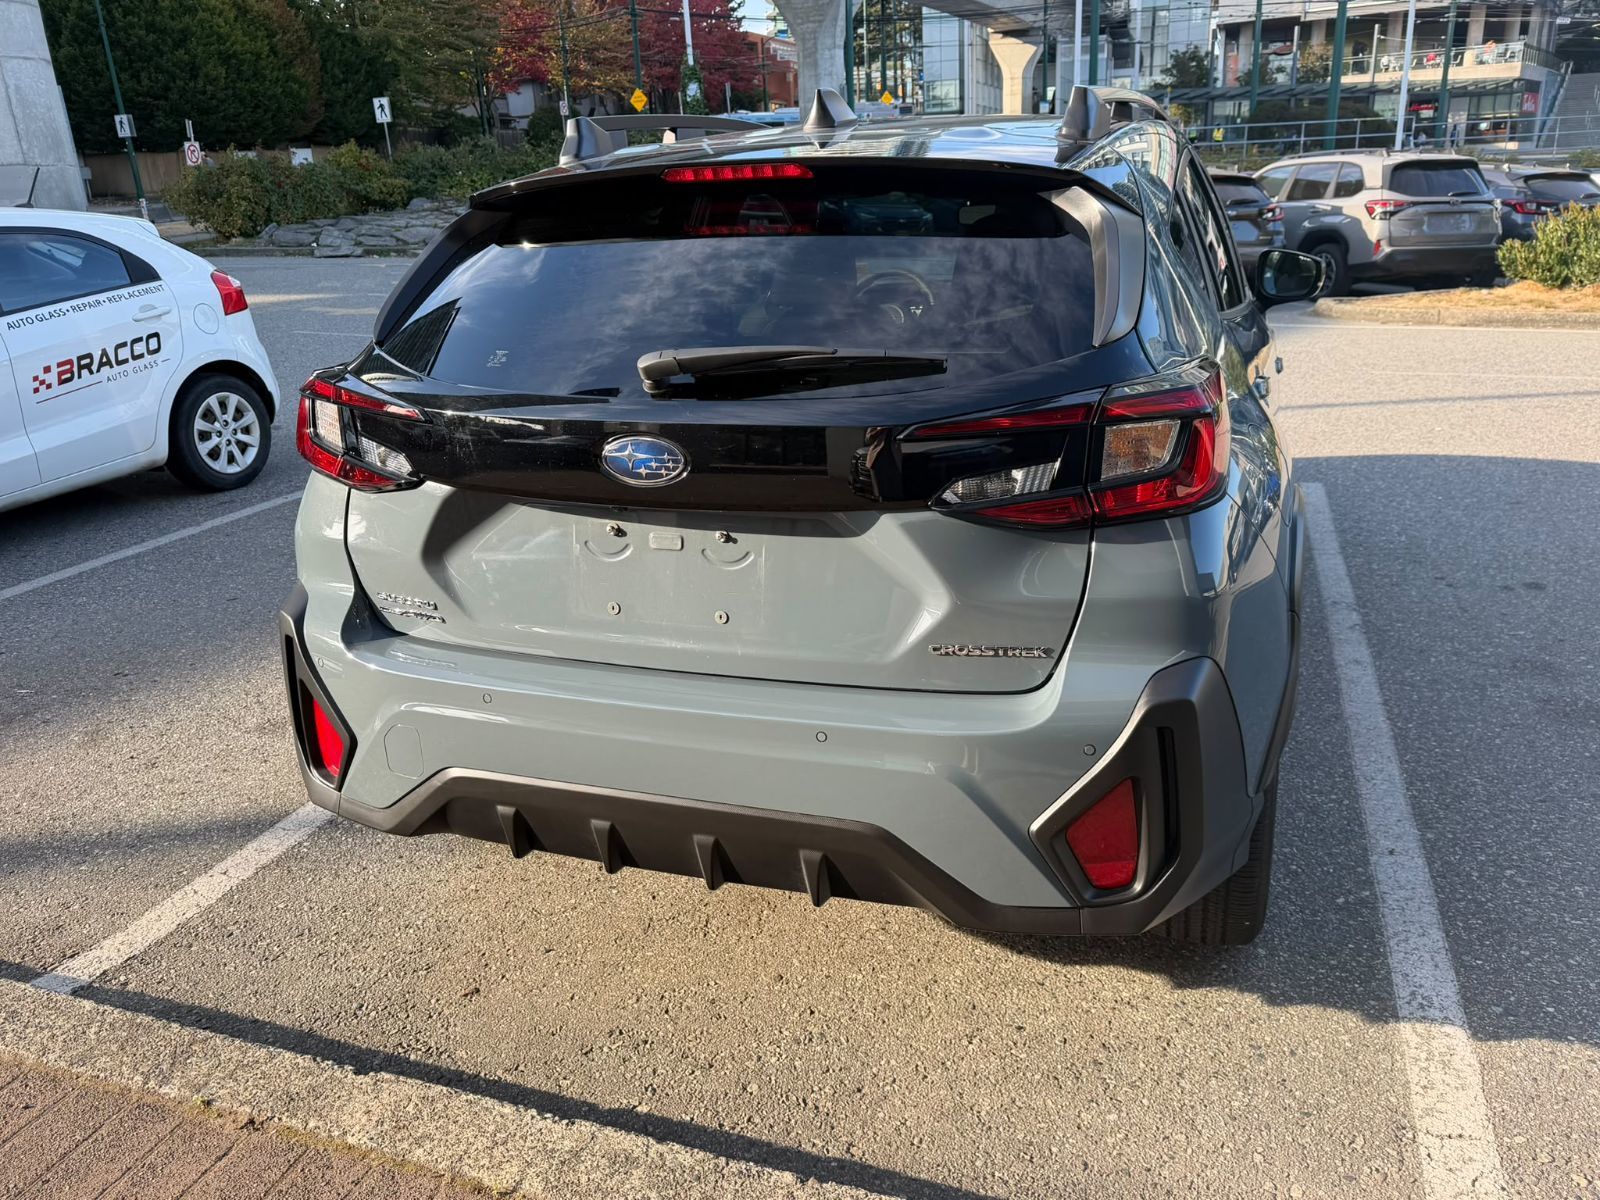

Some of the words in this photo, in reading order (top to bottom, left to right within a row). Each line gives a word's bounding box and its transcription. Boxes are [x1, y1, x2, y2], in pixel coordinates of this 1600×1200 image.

[6, 316, 35, 331] AUTO
[35, 308, 67, 323] GLASS
[70, 300, 104, 314] REPAIR
[106, 284, 165, 304] REPLACEMENT
[57, 331, 162, 386] BRACCO
[106, 370, 129, 383] AUTO
[132, 360, 159, 374] GLASS
[928, 644, 1050, 658] CROSSTREK
